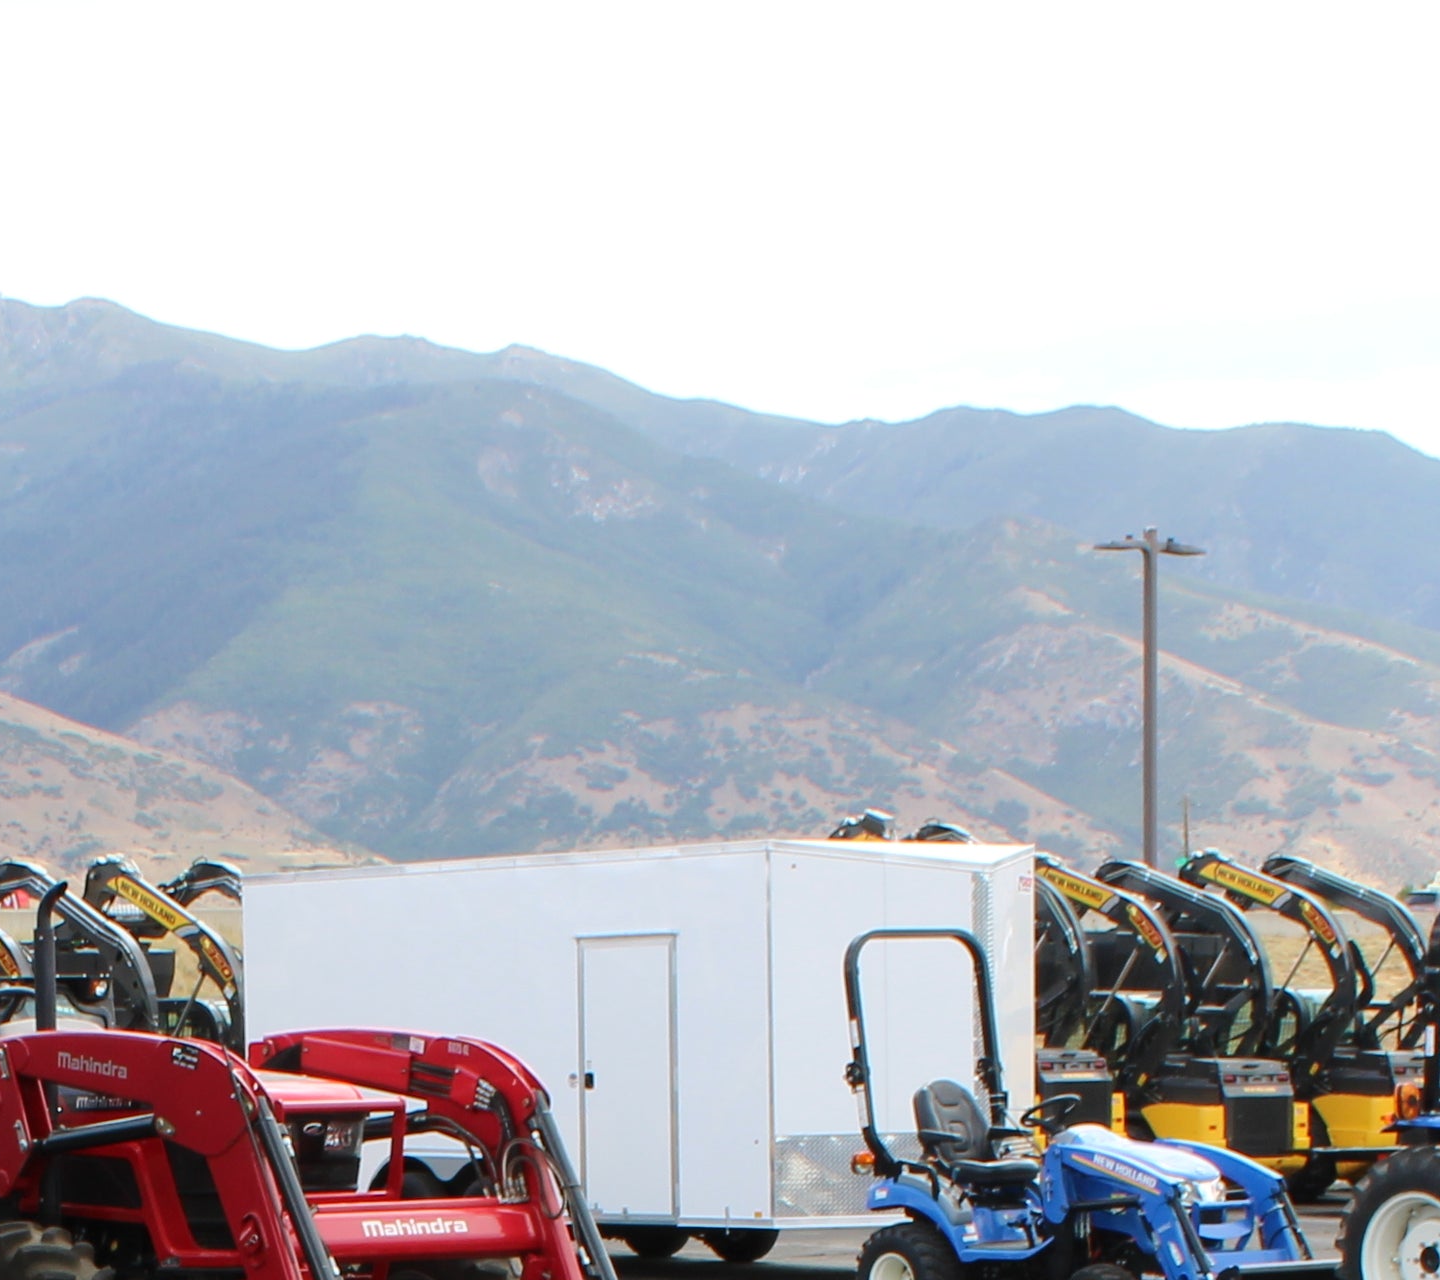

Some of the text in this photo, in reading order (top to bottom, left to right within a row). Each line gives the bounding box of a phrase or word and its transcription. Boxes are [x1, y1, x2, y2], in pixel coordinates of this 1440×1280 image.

[57, 1051, 128, 1079] Mahindra
[1092, 1153, 1158, 1189] NEW HOLLAND
[362, 1217, 468, 1238] Mahindra
